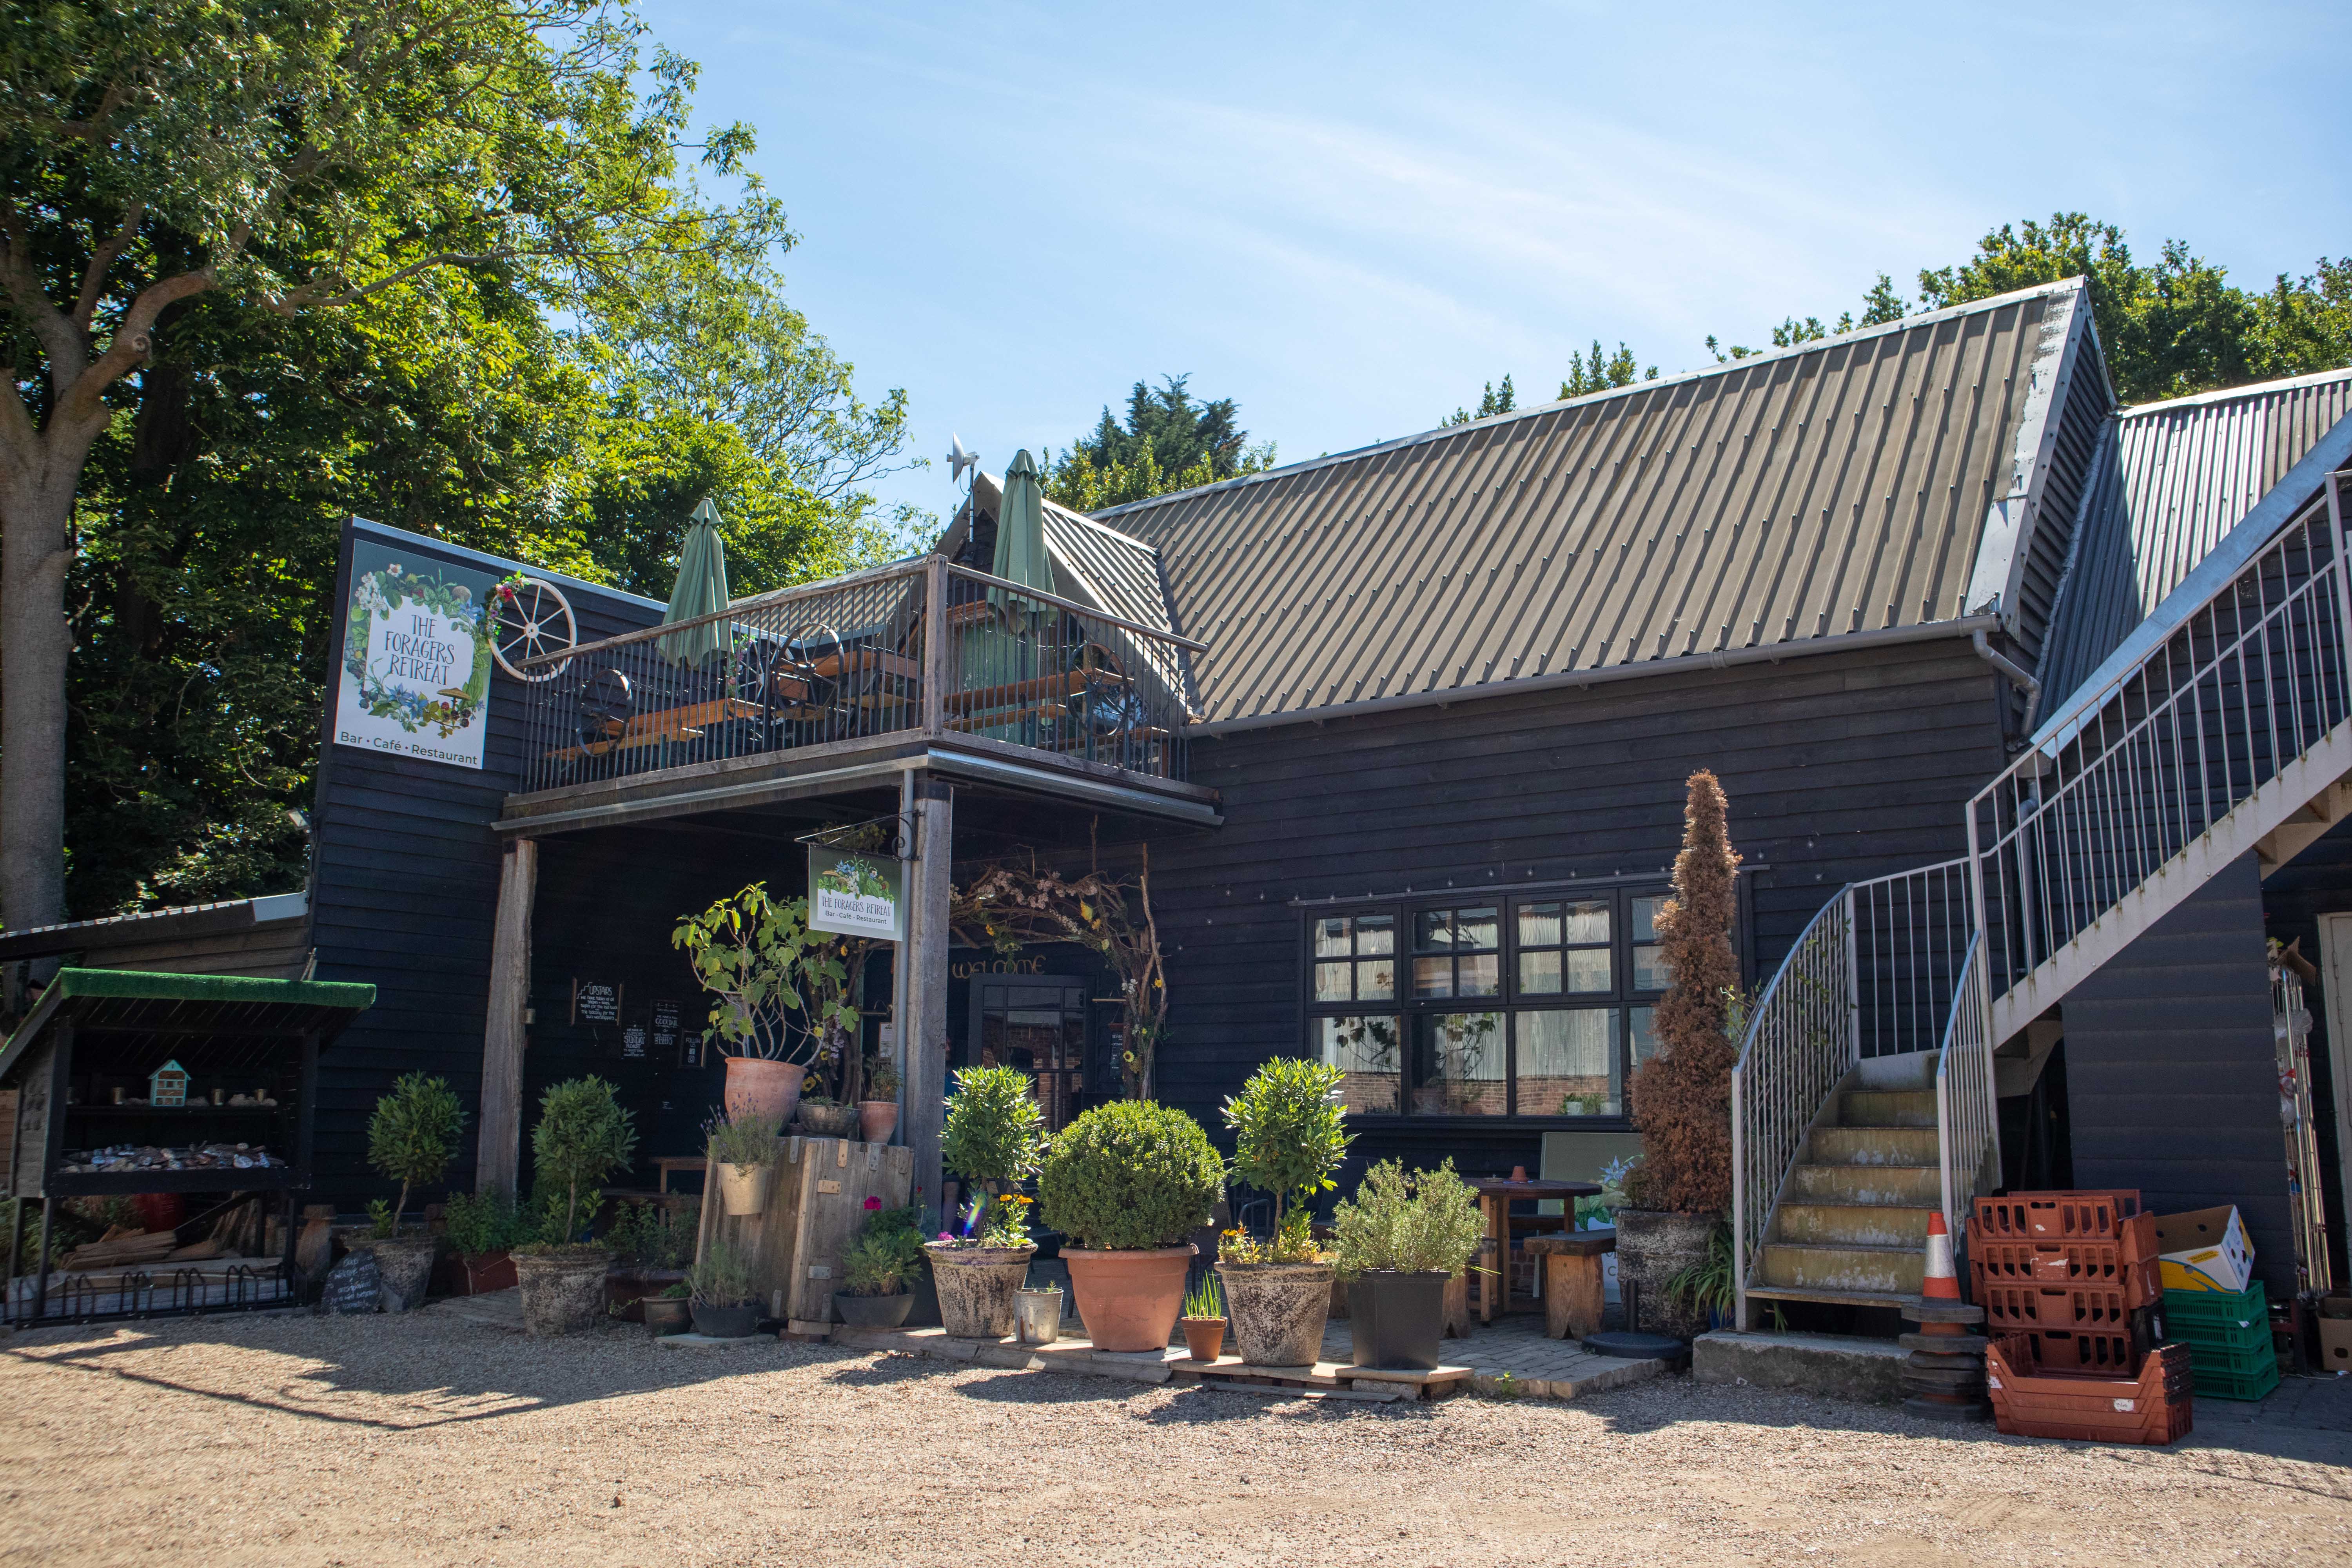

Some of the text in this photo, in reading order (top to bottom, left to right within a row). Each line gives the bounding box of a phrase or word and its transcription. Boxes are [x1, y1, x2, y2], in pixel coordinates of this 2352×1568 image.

[411, 614, 437, 638] THE
[385, 631, 455, 665] FORAGERS
[390, 654, 450, 686] RETREAT
[340, 731, 477, 765] Bar Café Restaurant
[822, 896, 891, 916] THE FORAGERS RETREAT
[857, 915, 887, 924] Restaurant
[589, 986, 612, 996] UPSTAIRS
[655, 1018, 678, 1026] COCKTAIL
[624, 1035, 644, 1044] SUNDAY
